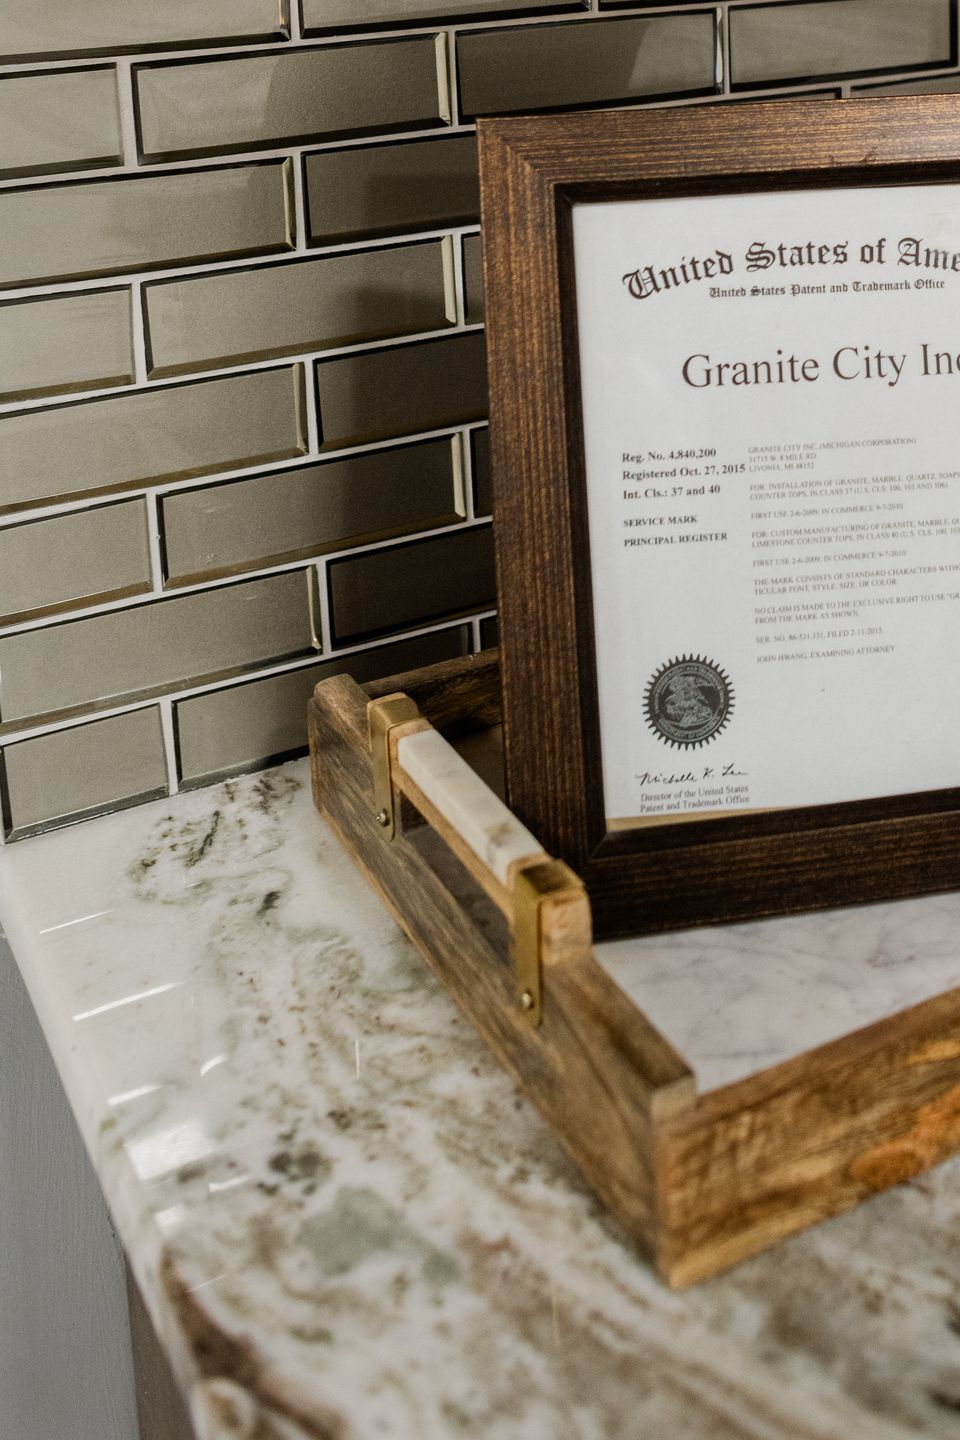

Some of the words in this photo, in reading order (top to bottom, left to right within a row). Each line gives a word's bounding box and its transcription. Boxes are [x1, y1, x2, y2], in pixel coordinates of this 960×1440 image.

[621, 250, 734, 301] United
[744, 240, 849, 272] States
[859, 237, 889, 264] of
[708, 287, 746, 299] United
[750, 284, 786, 297] States
[790, 283, 826, 297] Patent
[829, 282, 848, 293] and
[852, 280, 911, 293] Trademark
[914, 279, 946, 290] Office
[682, 349, 820, 389] Granite
[832, 345, 907, 387] City
[622, 453, 644, 463] Reg.
[648, 451, 665, 460] No.
[668, 448, 716, 460] 4,840,200
[622, 468, 677, 481] Registered
[680, 467, 701, 476] Oct.
[704, 466, 719, 476] 27,
[722, 464, 745, 474] 2015
[623, 490, 640, 499] Int.
[644, 488, 667, 498] Cls.:
[671, 487, 683, 496] 37
[686, 486, 705, 495] and
[708, 485, 720, 494] 40
[769, 481, 822, 490] INSTALLATION
[831, 505, 874, 514] COMMERCE
[624, 517, 665, 527] SERVICE
[668, 515, 697, 524] MARK
[771, 529, 802, 538] CUSTOM
[804, 525, 869, 535] MANUFACTURING
[624, 536, 676, 547] PRINCIPAL
[679, 533, 728, 543] REGISTER
[753, 559, 773, 567] FIRST
[834, 552, 876, 561] COMMERCE
[796, 575, 832, 583] CONSISTS
[846, 570, 886, 579] STANDARD
[888, 565, 937, 575] CHARACTERS
[755, 586, 786, 595] TICULAR
[767, 606, 792, 614] CLAIM
[802, 603, 824, 611] MADE
[853, 598, 894, 607] EXCLUSIVE
[896, 596, 918, 604] RIGHT
[810, 648, 854, 658] EXAMINING
[856, 646, 895, 654] ATTORNEY
[641, 792, 671, 802] Director
[674, 790, 682, 798] of
[684, 789, 696, 797] the
[698, 787, 724, 796] United
[726, 785, 749, 793] States
[640, 802, 664, 813] Patent
[667, 801, 680, 810] and
[683, 798, 723, 808] Trademark
[725, 795, 750, 804] Office
